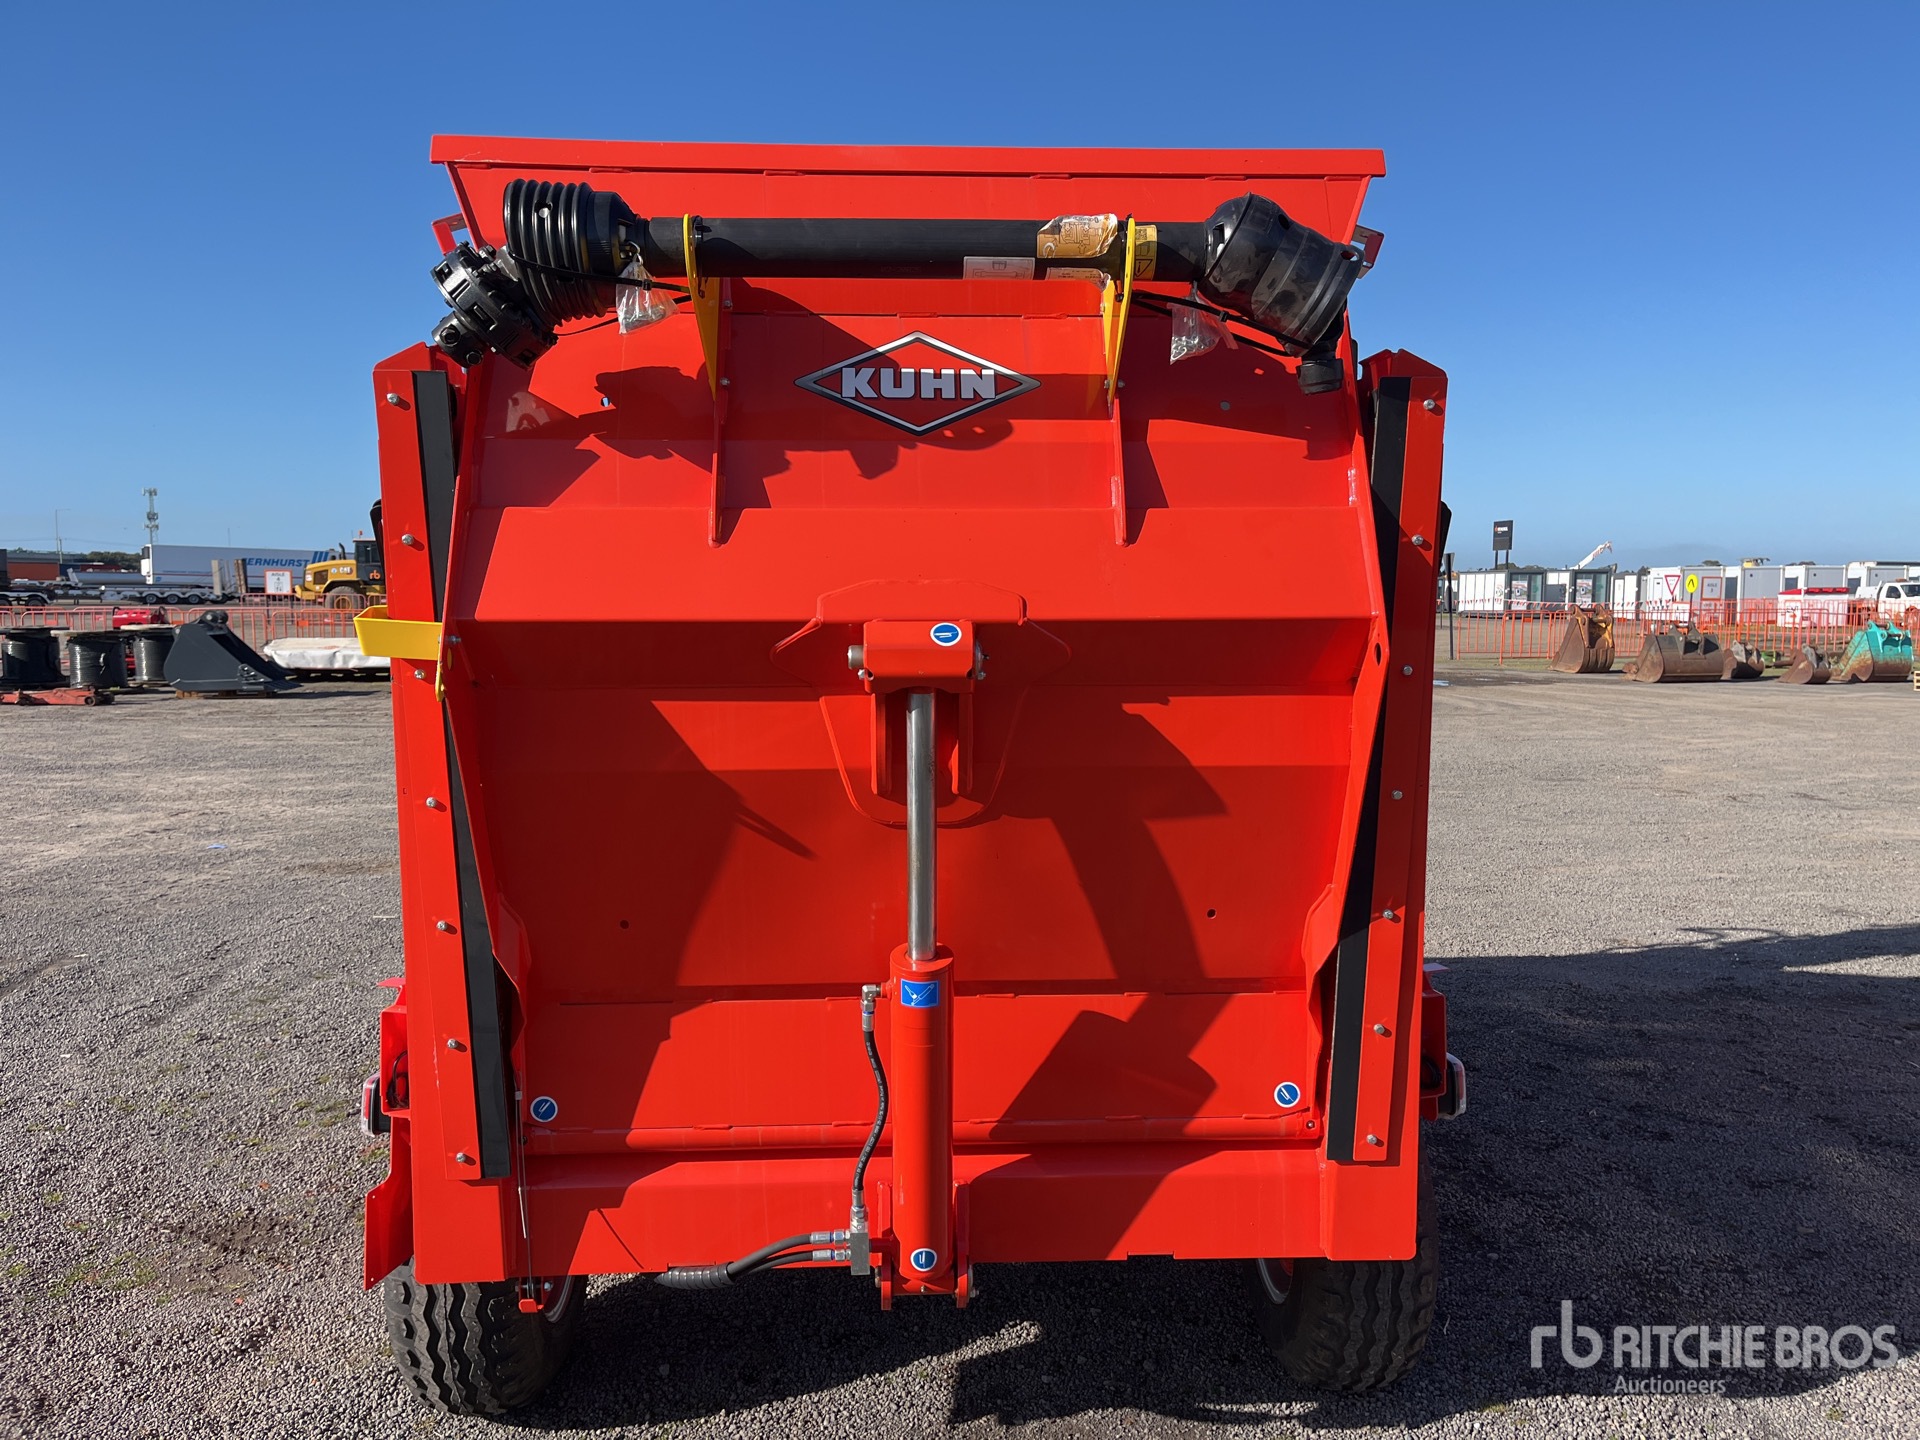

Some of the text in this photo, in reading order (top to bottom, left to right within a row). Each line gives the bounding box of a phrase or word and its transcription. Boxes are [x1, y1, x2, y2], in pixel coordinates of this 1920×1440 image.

[841, 366, 996, 399] KUHN
[246, 557, 310, 567] ERNHURST
[369, 569, 381, 580] rb
